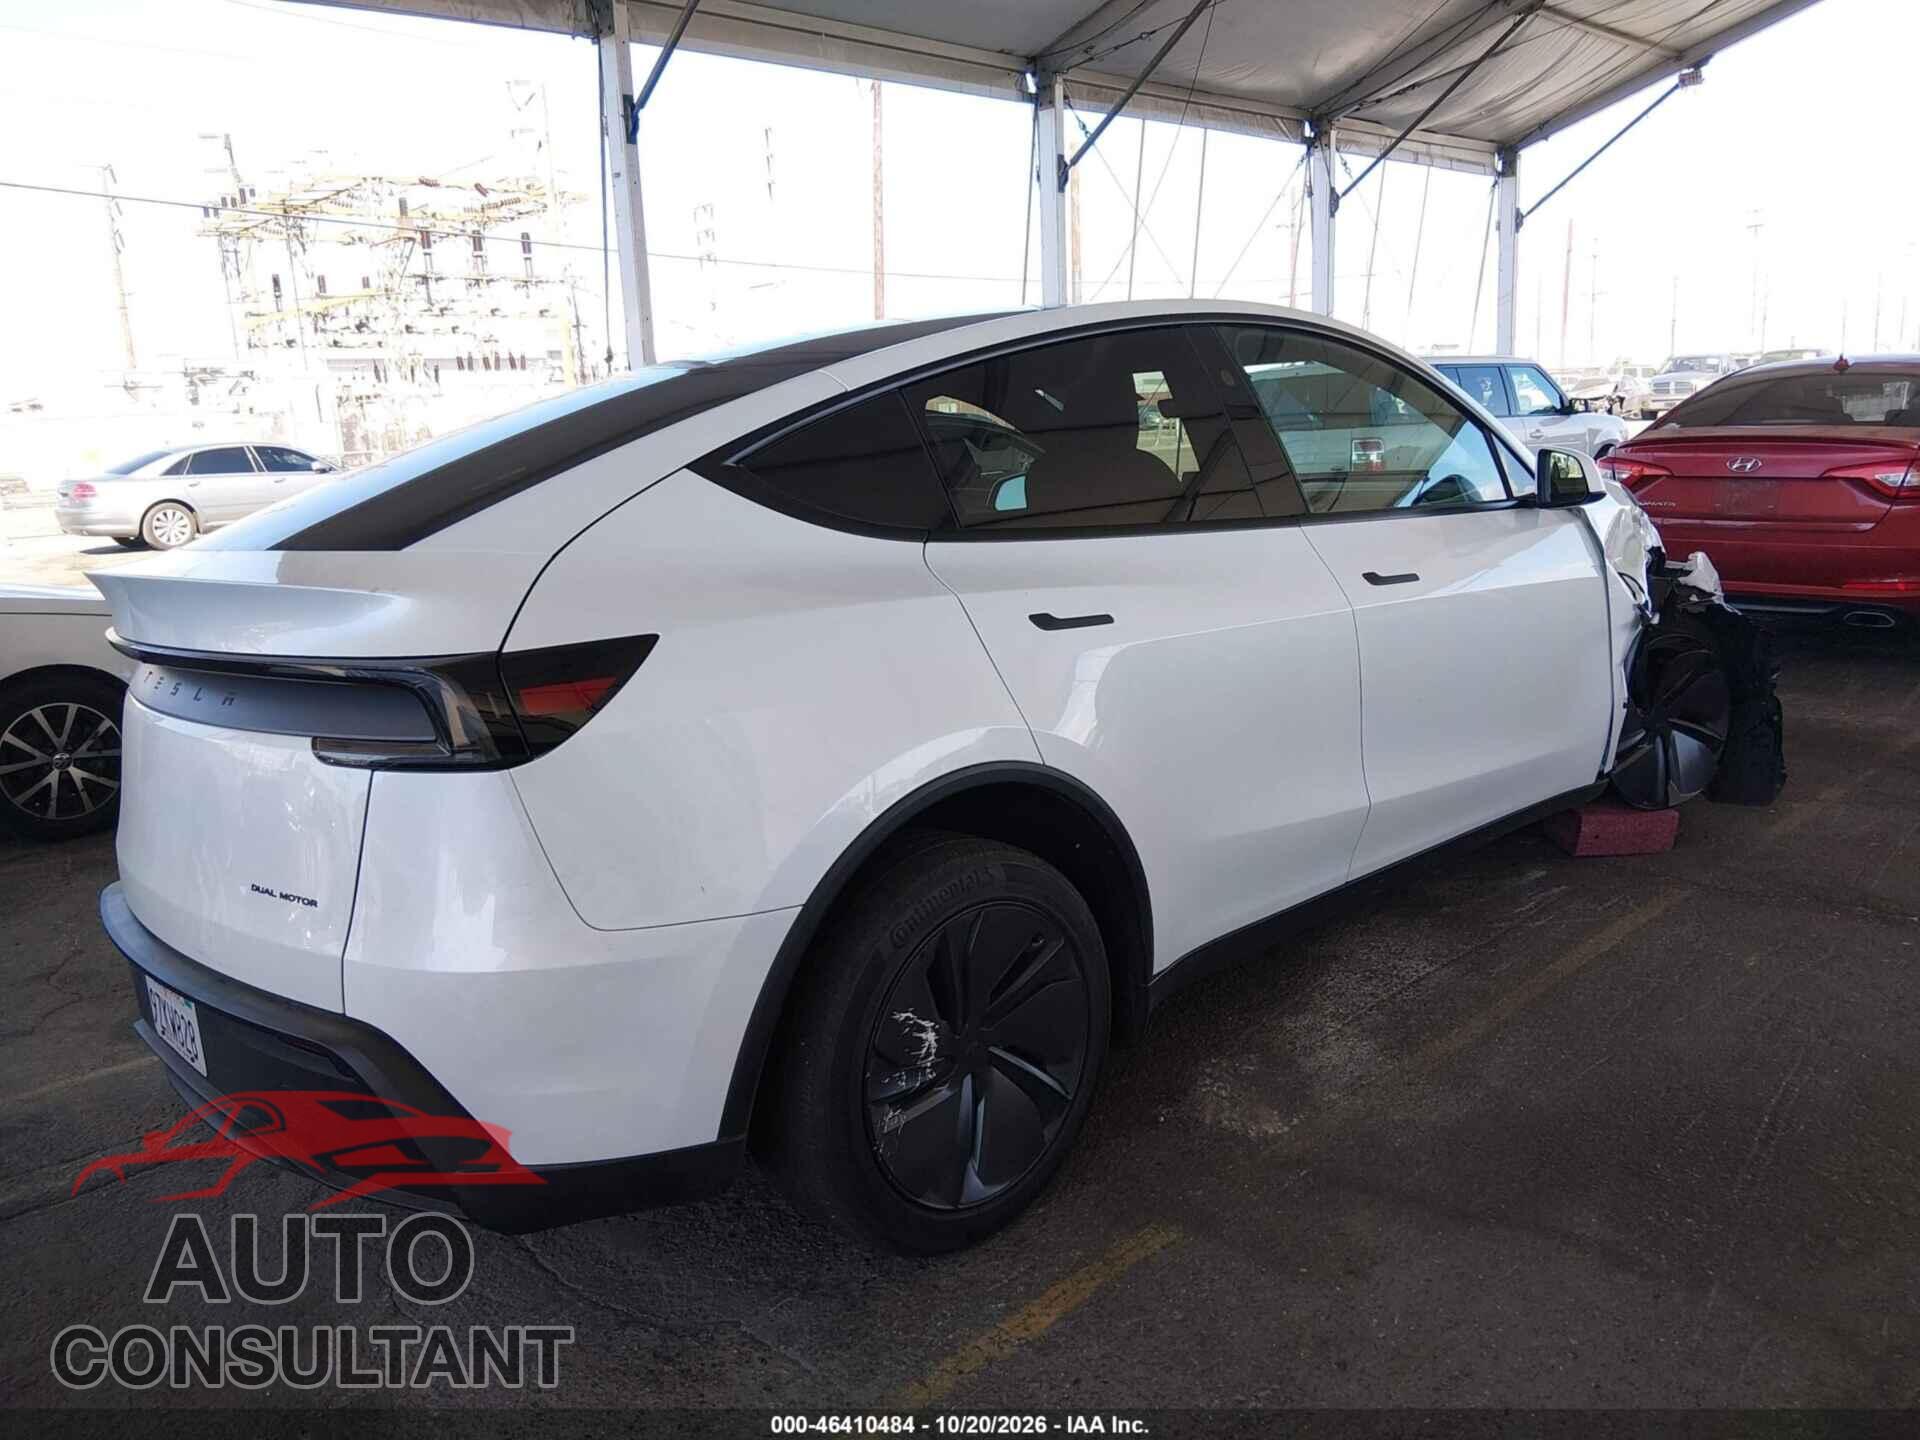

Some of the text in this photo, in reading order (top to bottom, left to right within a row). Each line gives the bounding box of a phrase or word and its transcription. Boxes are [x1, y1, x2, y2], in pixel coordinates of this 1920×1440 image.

[144, 671, 237, 706] TESLA
[251, 884, 318, 908] DUAL MOTOR
